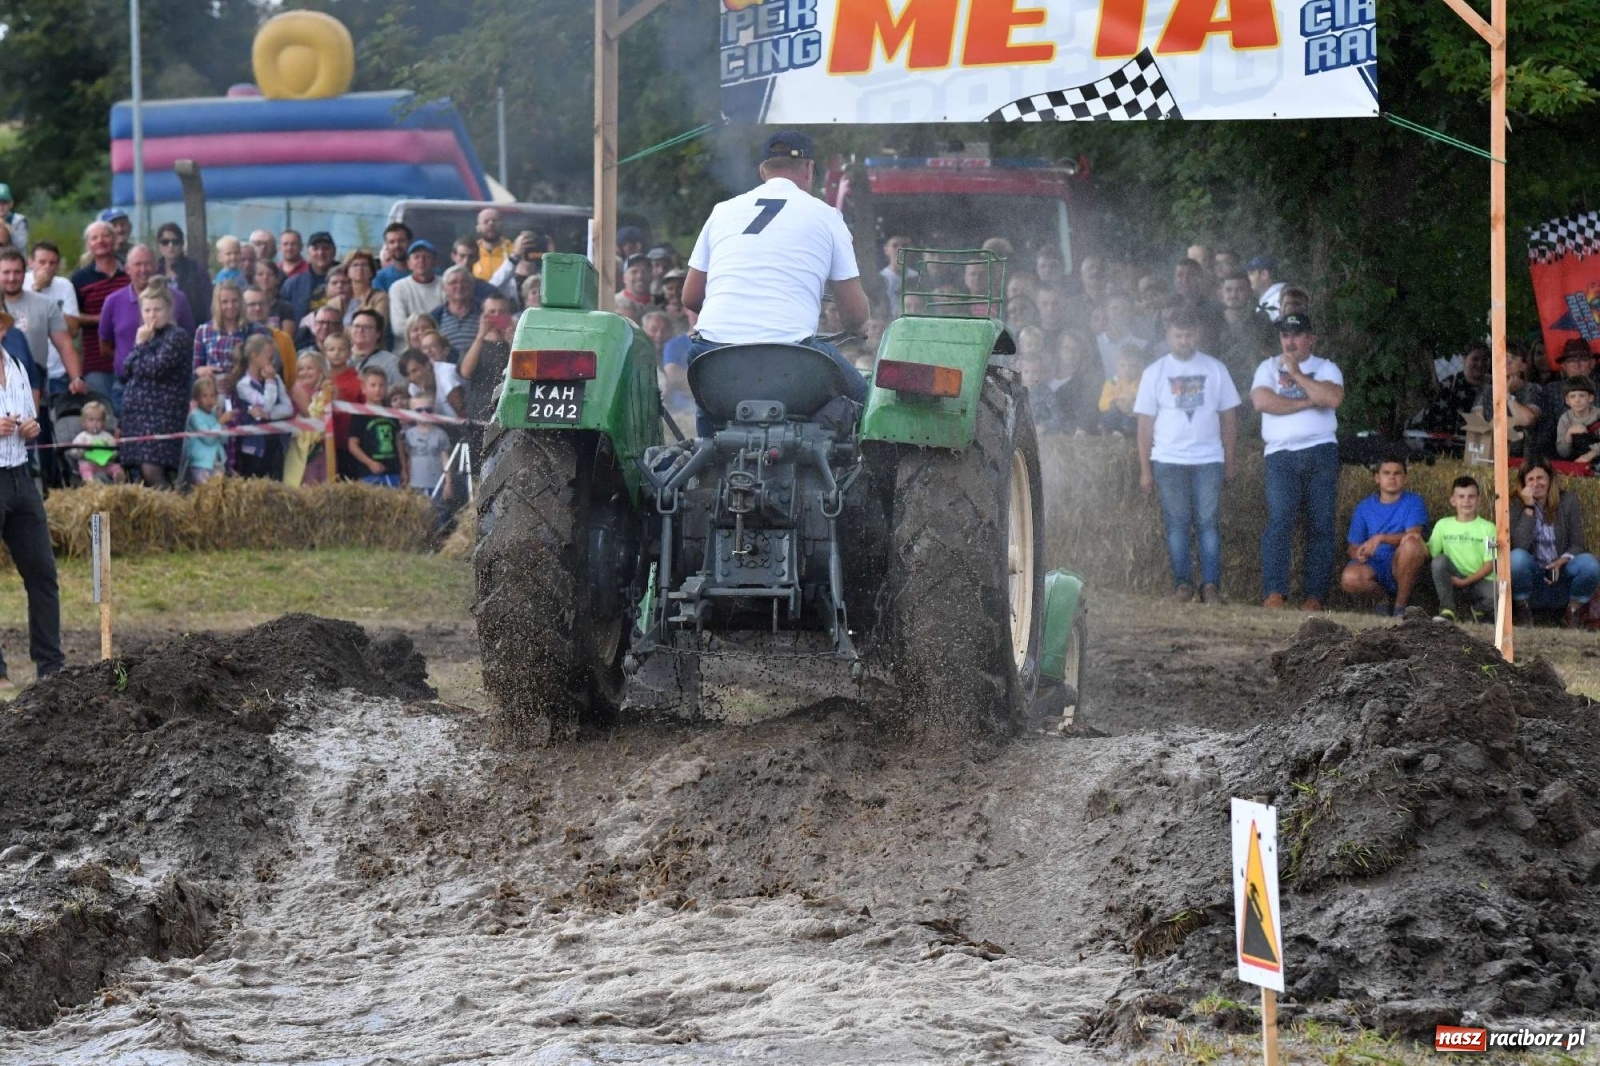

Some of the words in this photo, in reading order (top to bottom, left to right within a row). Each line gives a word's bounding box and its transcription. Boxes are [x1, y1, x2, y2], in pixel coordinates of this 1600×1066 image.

[826, 0, 1281, 76] META
[1305, 27, 1377, 76] RA
[741, 198, 788, 235] 7
[529, 403, 577, 418] 2042
[534, 385, 575, 400] KAH
